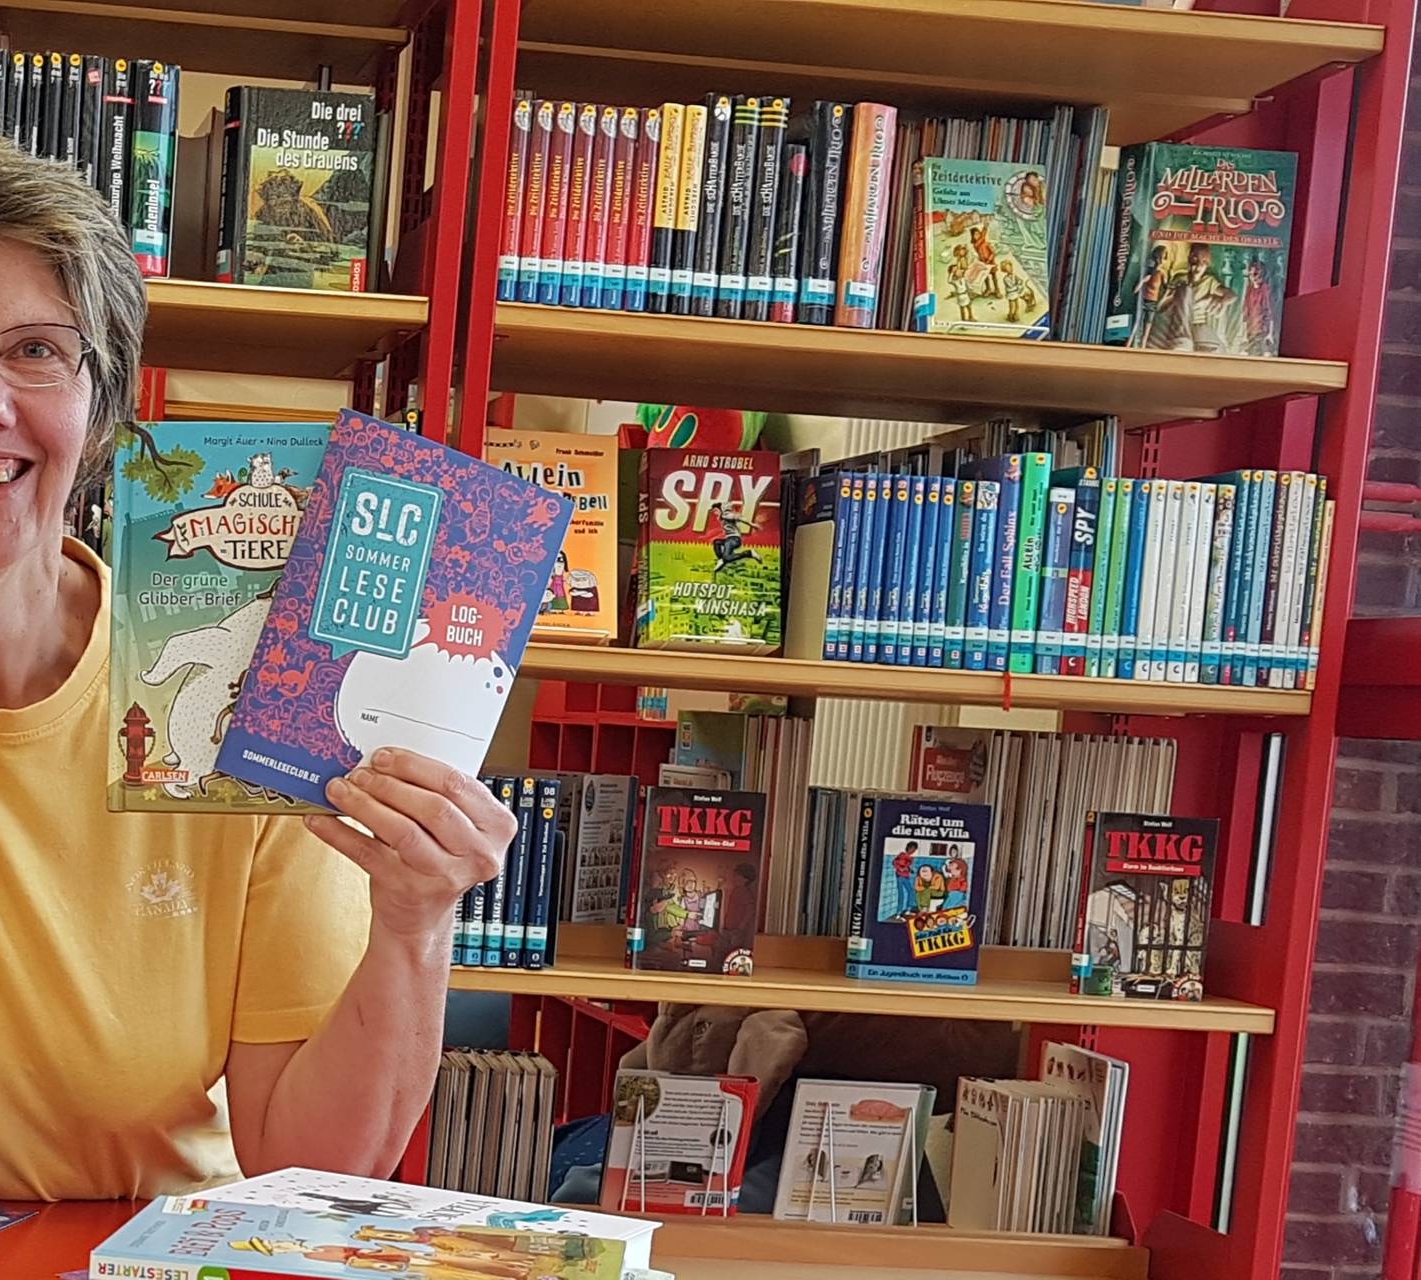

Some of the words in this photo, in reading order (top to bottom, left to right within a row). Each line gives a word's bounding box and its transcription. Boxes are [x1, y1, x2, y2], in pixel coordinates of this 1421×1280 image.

[312, 102, 332, 120] Die
[336, 103, 361, 121] drei
[257, 129, 278, 147] Die
[283, 130, 329, 149] Stunde
[276, 151, 300, 167] des
[303, 152, 357, 170] Grauens
[932, 171, 1002, 186] Zeitdetektive
[1159, 165, 1280, 196] MILLIARDEN
[1193, 195, 1259, 228] TRIO
[352, 262, 361, 293] OSMOS
[204, 437, 232, 446] Margit
[236, 437, 256, 445] Auer
[267, 438, 287, 446] Nina
[290, 438, 323, 446] Dulleck
[683, 456, 710, 467] ARNO
[712, 456, 753, 469] STROBEL
[239, 493, 282, 507] SCHULE
[656, 470, 772, 534] SPY
[189, 514, 302, 538] MAGISCH
[351, 492, 422, 546] SLC
[1074, 507, 1096, 545] SPY
[1002, 511, 1017, 551] Sphinx
[225, 540, 288, 559] TIERE
[345, 545, 411, 572] SOMMER
[152, 573, 178, 586] Der
[182, 573, 228, 588] grüne
[340, 571, 406, 604] LESE
[674, 582, 735, 599] HOTSPOT
[139, 592, 240, 606] Glibber-Brief
[998, 582, 1010, 605] Der
[332, 598, 397, 634] CLUB
[451, 605, 482, 624] LOG-
[696, 601, 767, 617] KINSHASA
[446, 626, 483, 646] BUCH
[361, 713, 379, 724] NAME
[142, 771, 187, 782] CARLSEN
[242, 750, 320, 783] SOMMERLESECLUB.DE
[657, 806, 752, 836] TKKG
[900, 814, 940, 826] Rätsel
[943, 819, 964, 827] um
[892, 826, 911, 835] die
[914, 827, 938, 836] alte
[939, 828, 969, 838] Villa
[1106, 832, 1203, 861] TKKG
[916, 932, 965, 952] TKKG
[98, 1263, 189, 1279] LESESTARTER
